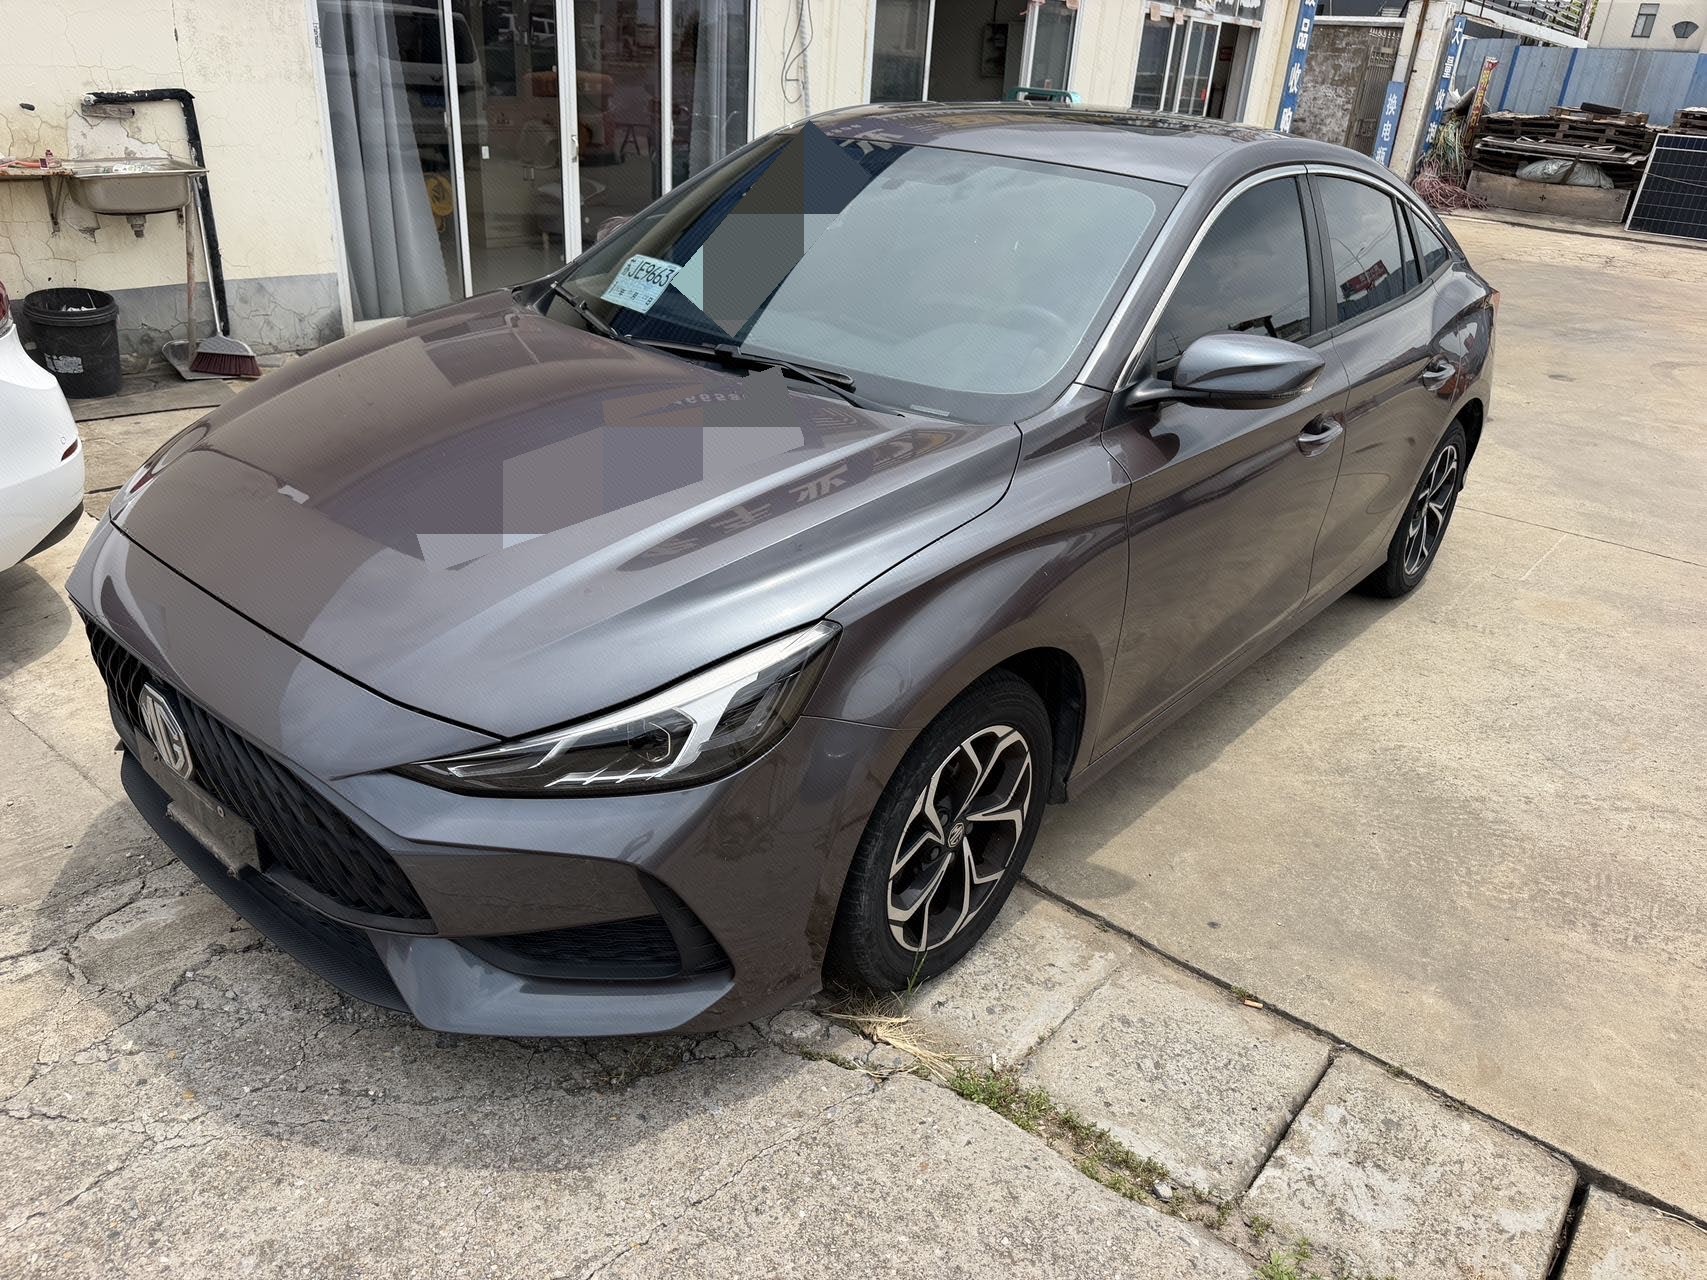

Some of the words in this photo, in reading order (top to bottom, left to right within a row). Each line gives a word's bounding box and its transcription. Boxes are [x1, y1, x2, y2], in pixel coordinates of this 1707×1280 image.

[1280, 0, 1316, 134] 品收购
[628, 260, 674, 287] JE9663
[140, 693, 187, 773] MG
